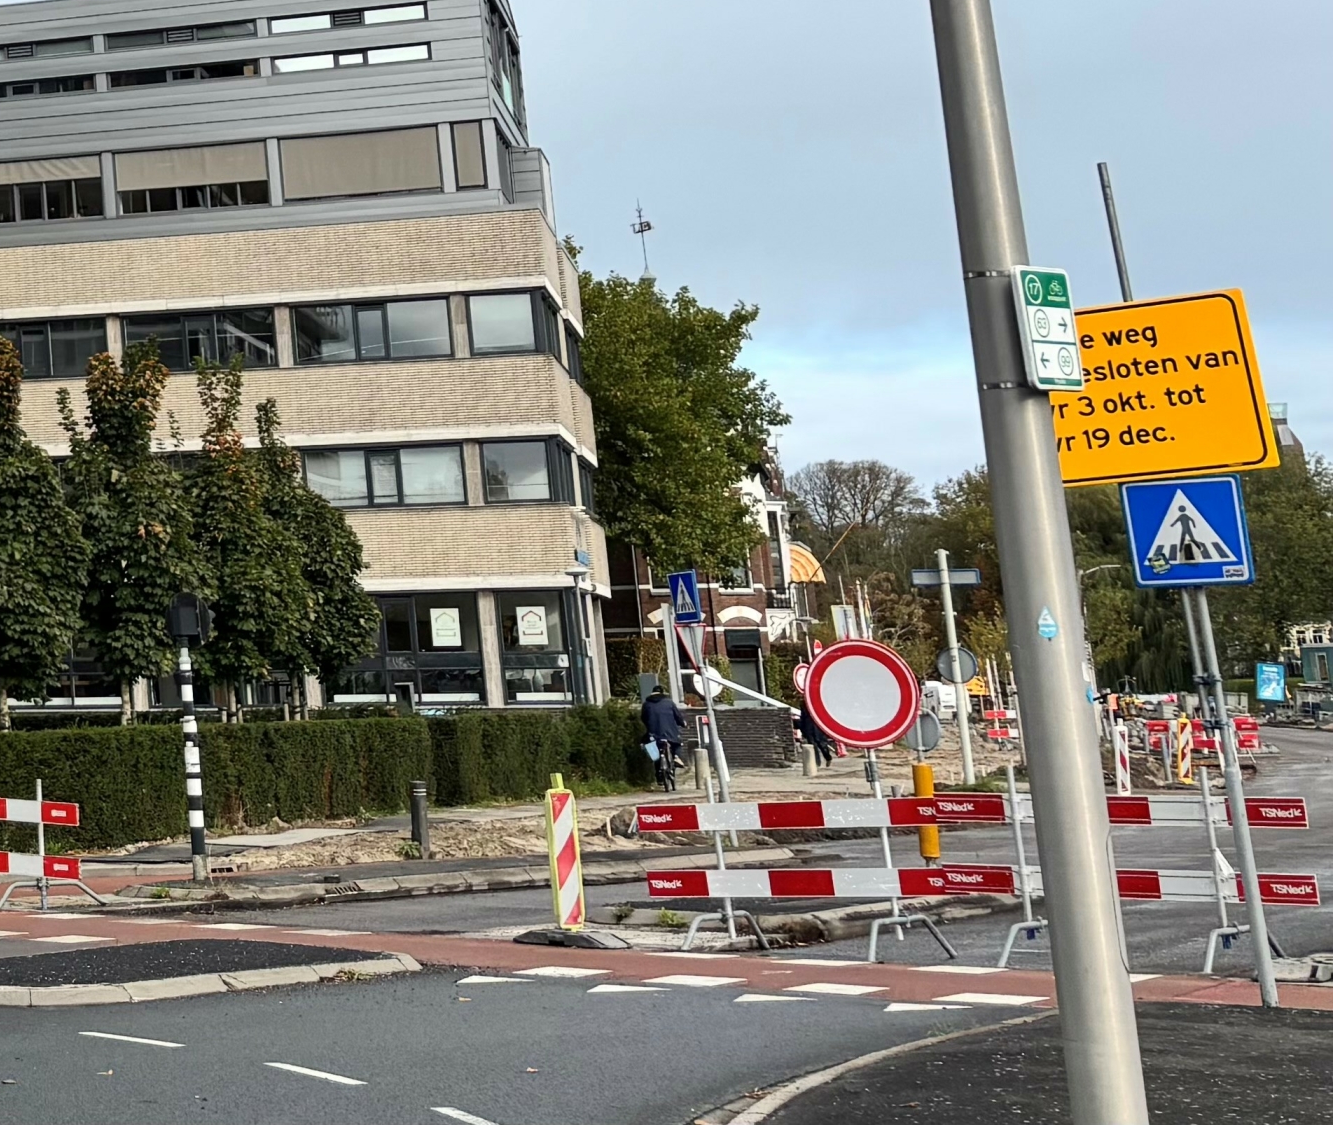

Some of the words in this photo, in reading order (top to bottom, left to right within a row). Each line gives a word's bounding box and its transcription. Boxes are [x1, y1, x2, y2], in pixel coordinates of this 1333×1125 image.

[1028, 282, 1040, 295] 17
[1102, 325, 1158, 348] weg
[1082, 356, 1179, 383] esloten
[1185, 349, 1240, 371] van
[1077, 395, 1095, 417] 3
[1103, 391, 1156, 414] okt.
[1164, 383, 1206, 407] tot
[1082, 428, 1110, 450] 19
[1119, 425, 1176, 446] dec.
